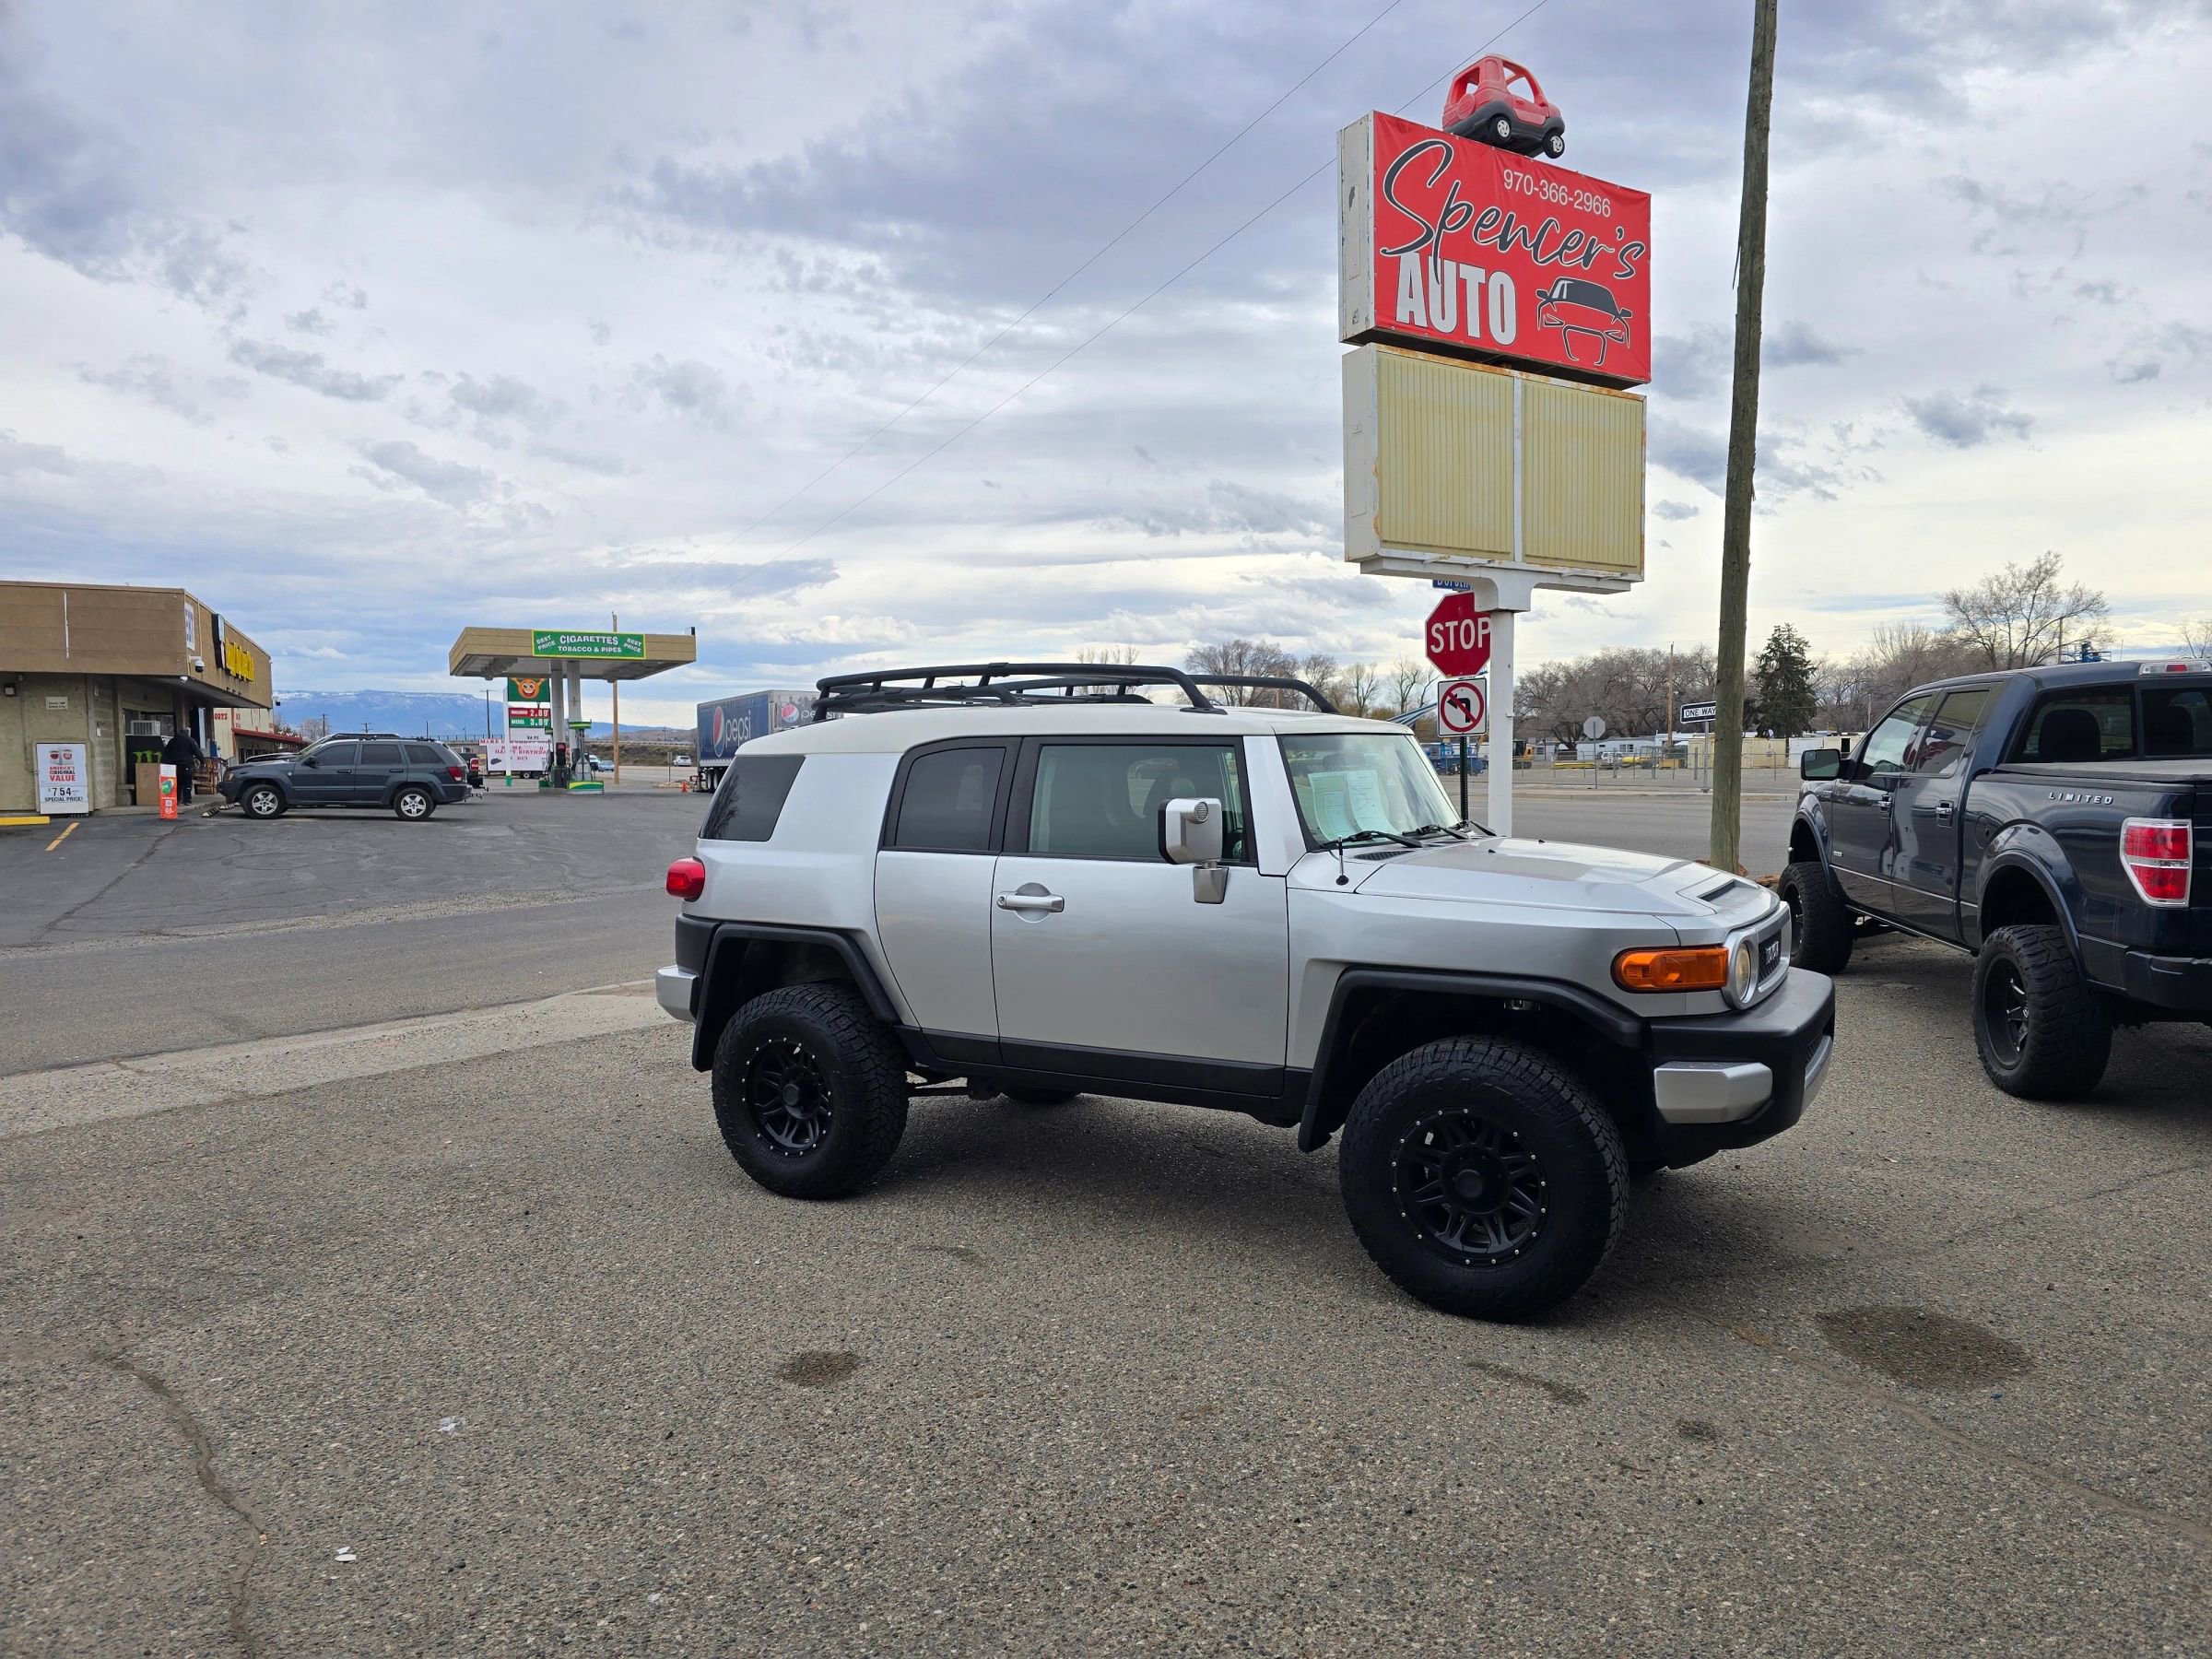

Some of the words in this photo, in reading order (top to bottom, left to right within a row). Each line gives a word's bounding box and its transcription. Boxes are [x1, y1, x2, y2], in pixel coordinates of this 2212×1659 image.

[1503, 169, 1611, 218] 970-366-2966
[1380, 138, 1646, 286] Spencer's
[1395, 251, 1517, 347] AUTO
[535, 634, 552, 644] BEST
[559, 635, 618, 645] CIGARETTES
[1430, 617, 1491, 653] STOP
[537, 641, 556, 651] PRICE
[623, 642, 641, 653] PRICE
[627, 638, 642, 647] BEST
[800, 709, 837, 721] pesi
[1686, 709, 1700, 717] ONE
[1701, 707, 1716, 715] WAY
[724, 710, 751, 747] pepsi
[2048, 792, 2114, 806] LIMITED
